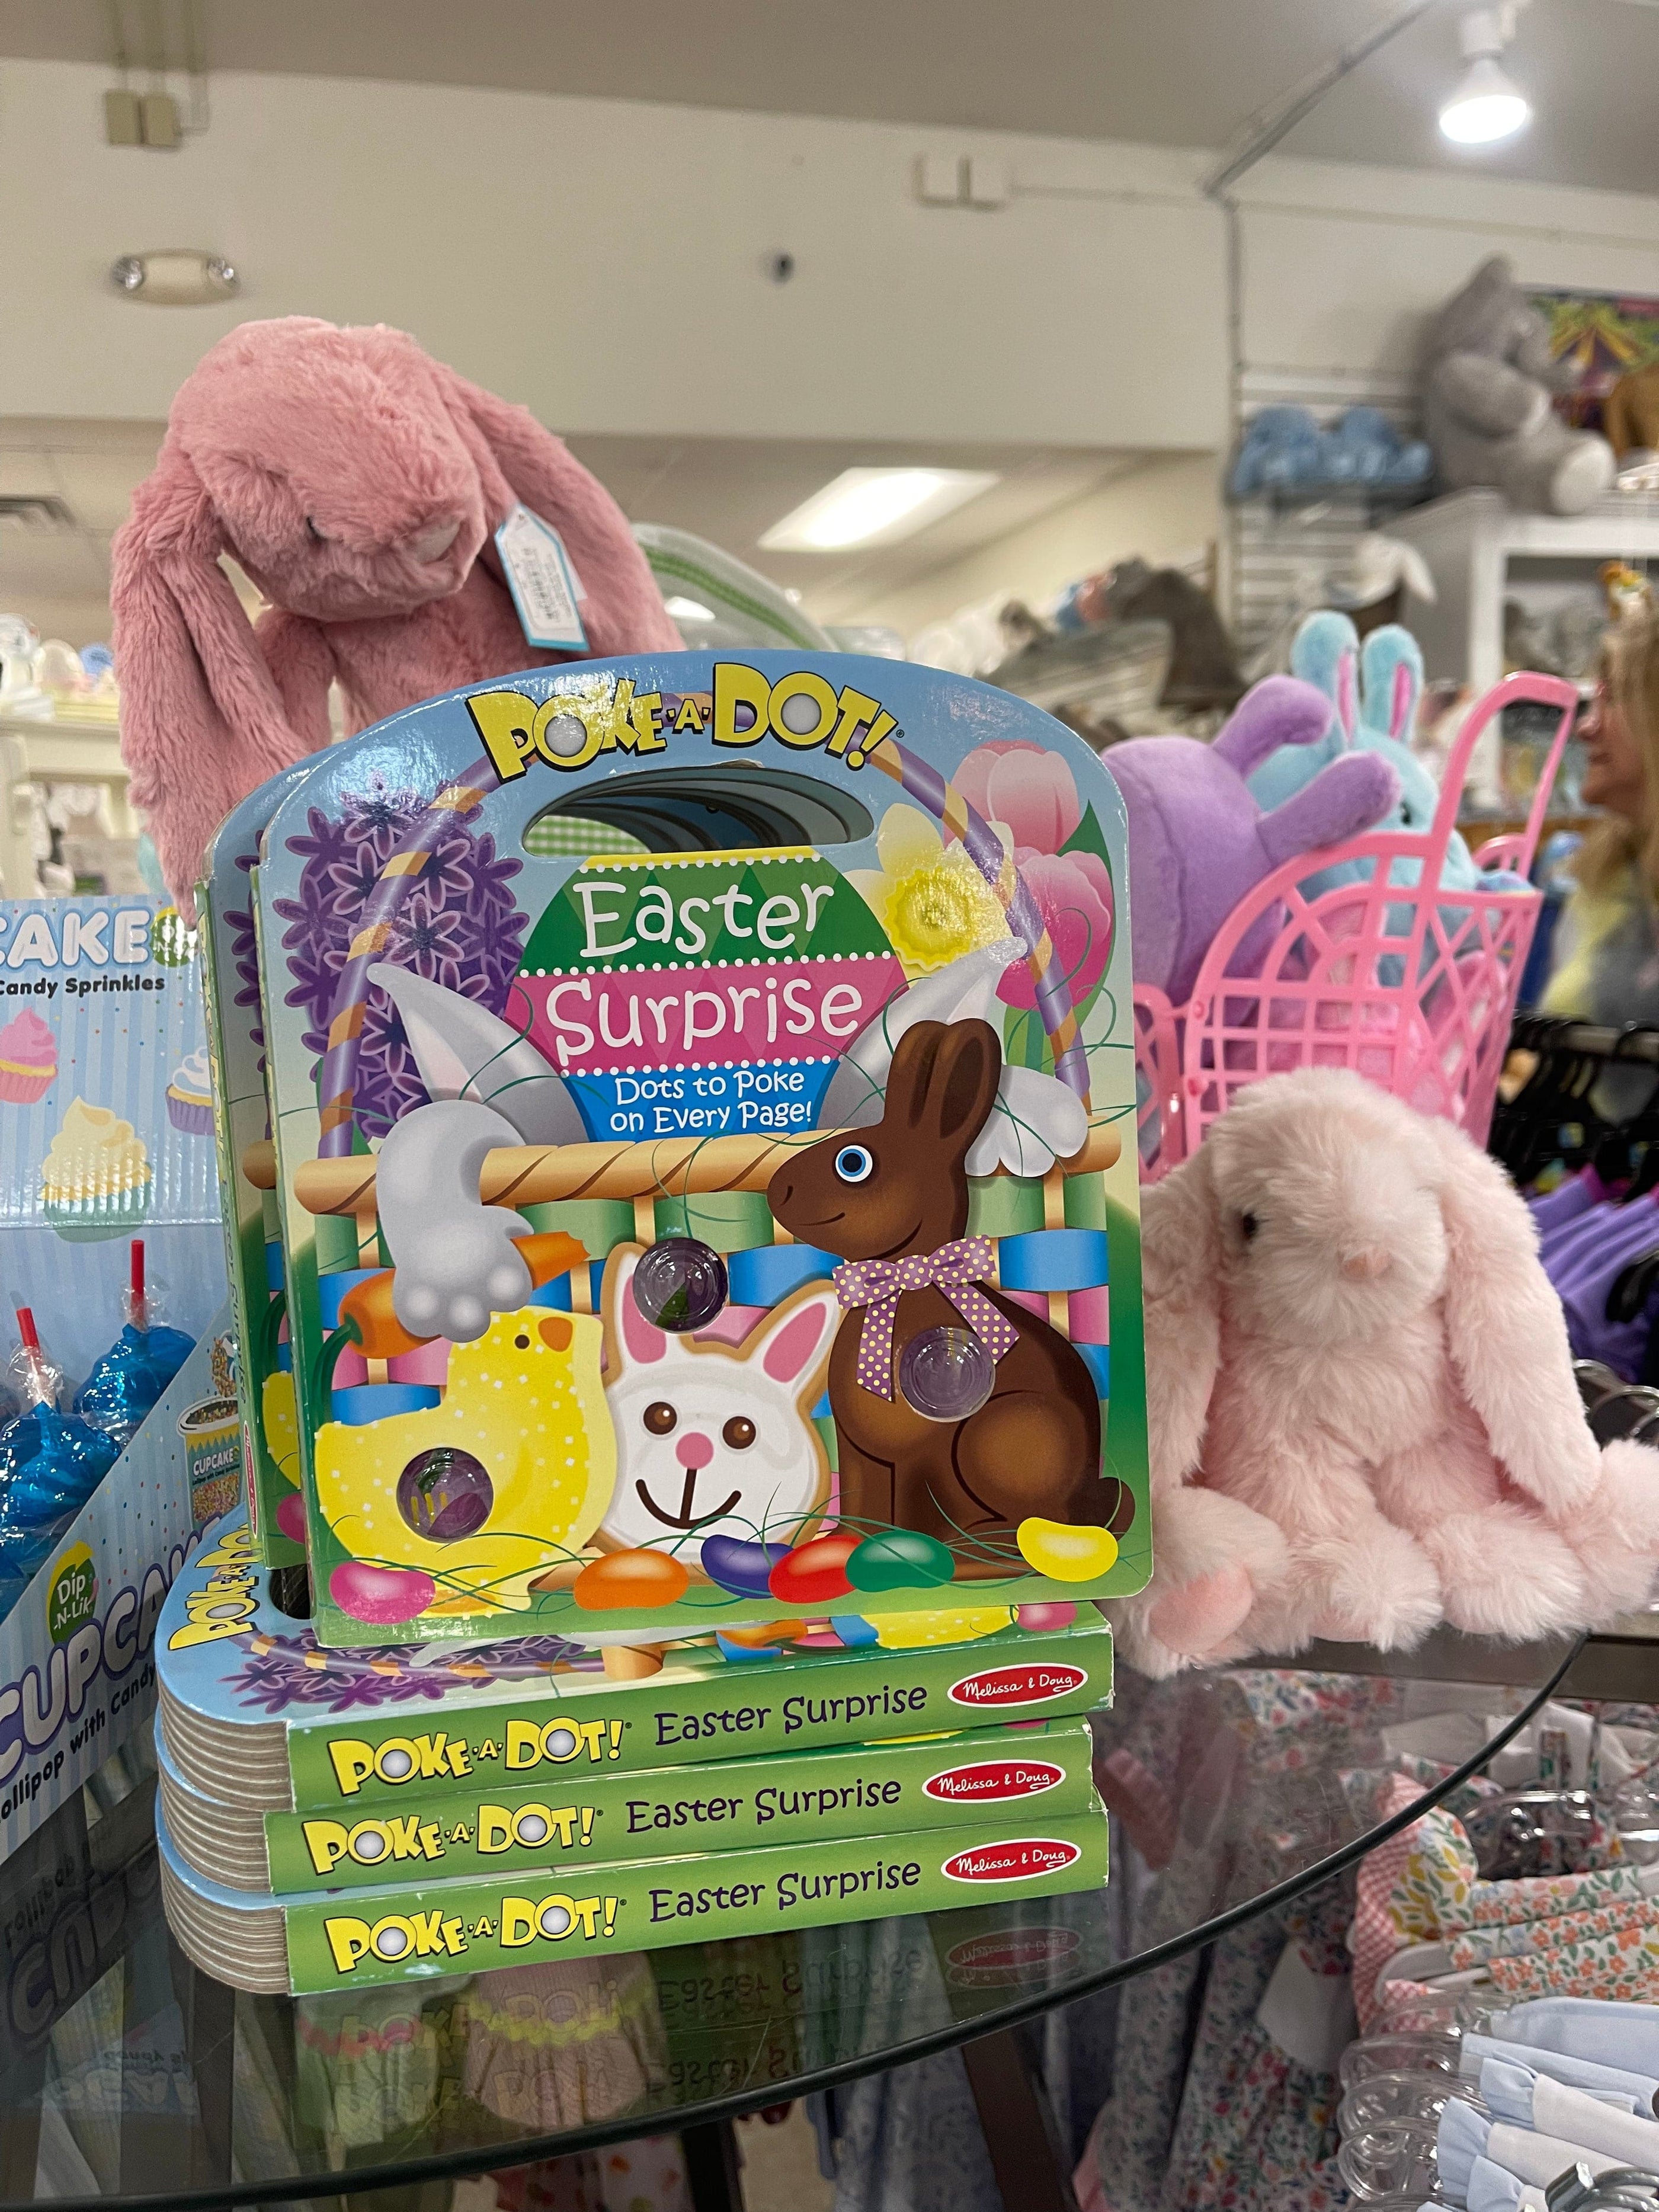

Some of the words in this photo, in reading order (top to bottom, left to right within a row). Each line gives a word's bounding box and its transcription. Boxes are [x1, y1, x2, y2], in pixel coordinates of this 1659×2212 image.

[573, 881, 834, 958] Easter
[0, 910, 150, 968] AKE
[65, 974, 165, 997] Sprinkles
[546, 978, 862, 1066] Surprise
[615, 1077, 684, 1105] Dots
[693, 1074, 726, 1097] to
[733, 1070, 805, 1098] Poke
[610, 1113, 644, 1132] on
[654, 1106, 731, 1133] Every
[737, 1100, 812, 1128] Page!
[193, 1448, 233, 1476] CUPCAKE
[57, 1571, 86, 1605] Dip
[963, 1682, 1023, 1700] Melissa
[1028, 1677, 1035, 1688] &
[1039, 1674, 1072, 1692] Doug
[654, 1706, 771, 1746] Easter
[783, 1685, 928, 1734] Surprise
[0, 1750, 65, 1824] ollipop
[70, 1708, 105, 1755] with
[111, 1661, 156, 1715] Candy
[937, 1777, 999, 1795] Melissa
[1004, 1774, 1011, 1785] &
[1016, 1771, 1051, 1790] Doug
[626, 1795, 743, 1833] Easter
[755, 1778, 902, 1824] Surprise
[956, 1855, 1017, 1875] Melissa
[1021, 1852, 1029, 1864] &
[1033, 1849, 1066, 1868] Doug
[648, 1883, 766, 1922] Easter
[777, 1861, 921, 1910] Surprise
